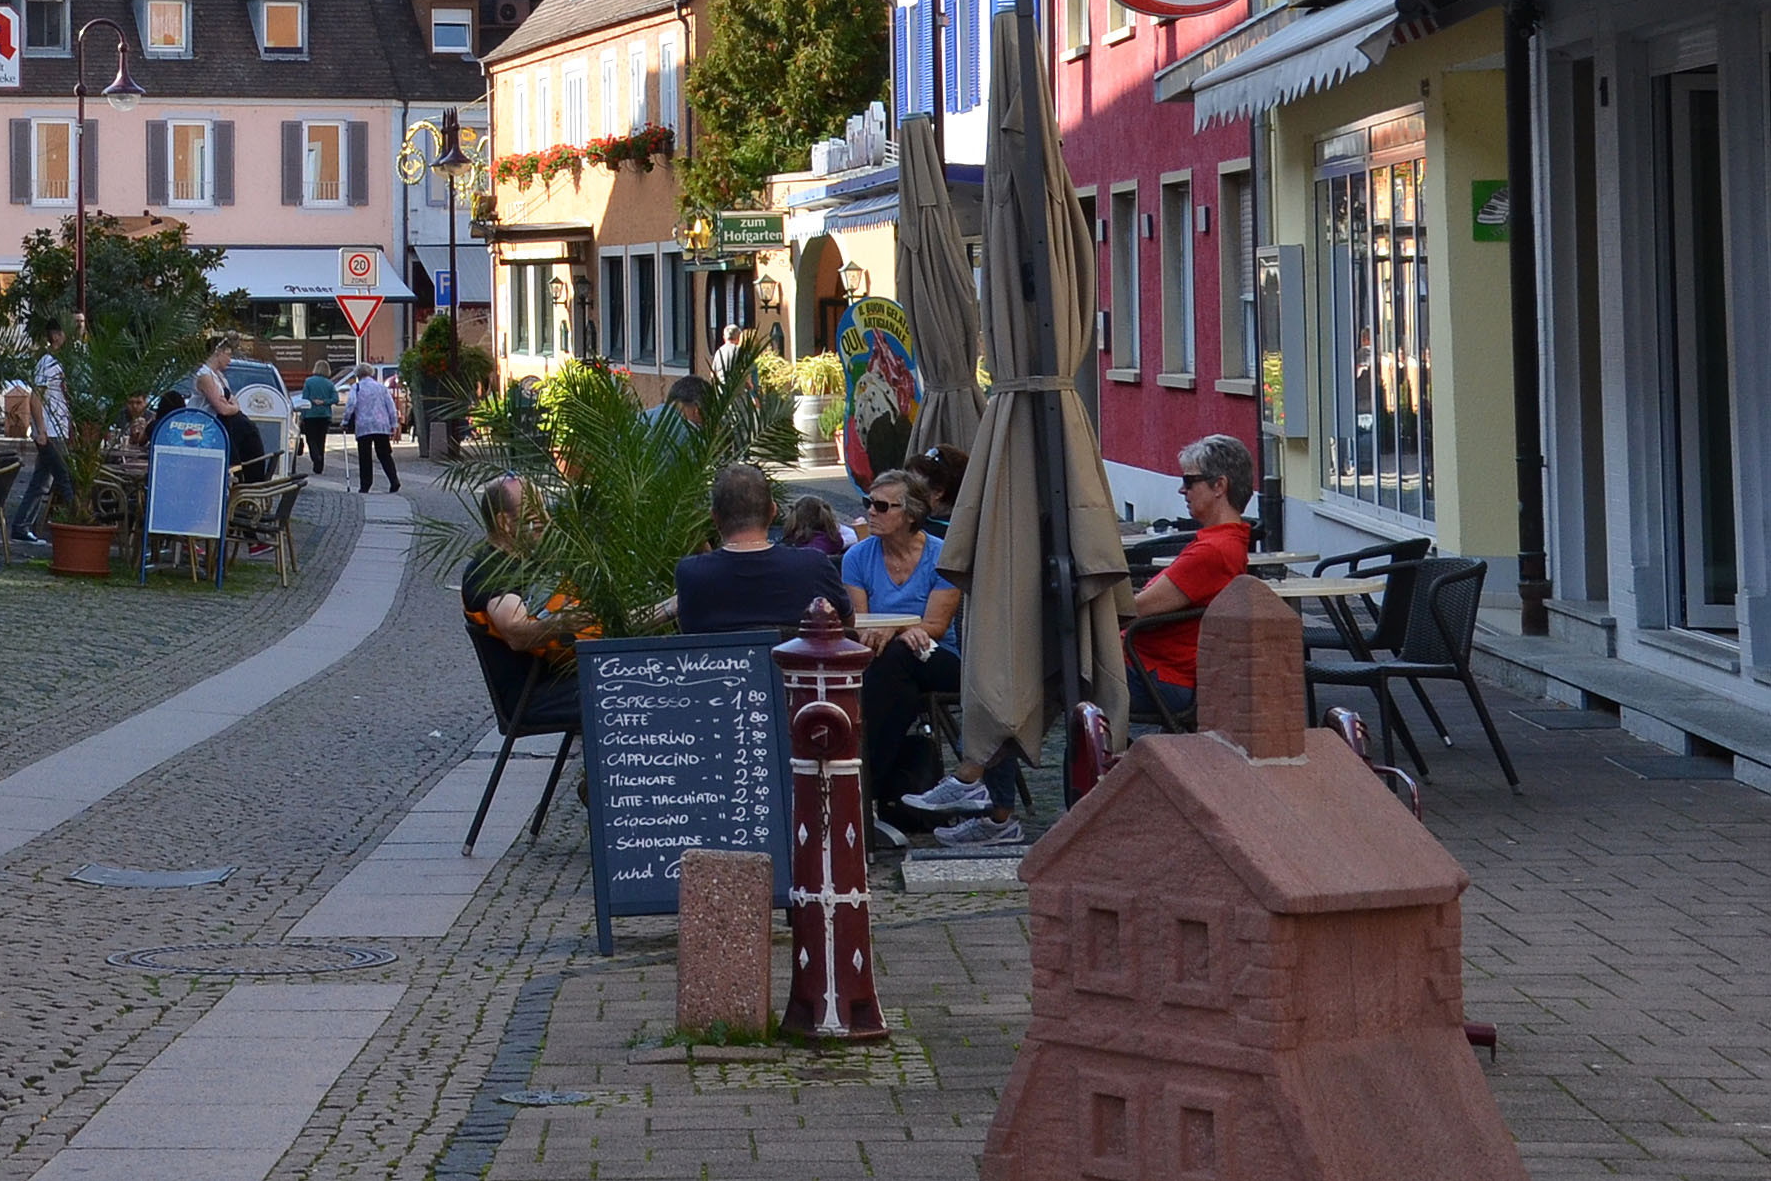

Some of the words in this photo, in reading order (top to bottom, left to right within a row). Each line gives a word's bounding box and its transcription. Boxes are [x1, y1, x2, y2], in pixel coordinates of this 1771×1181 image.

[740, 218, 766, 227] zum
[723, 229, 783, 244] Hofgarten
[353, 259, 366, 271] 20
[841, 327, 864, 357] QUI
[600, 695, 690, 710] ESPRESSO
[612, 862, 654, 881] und
